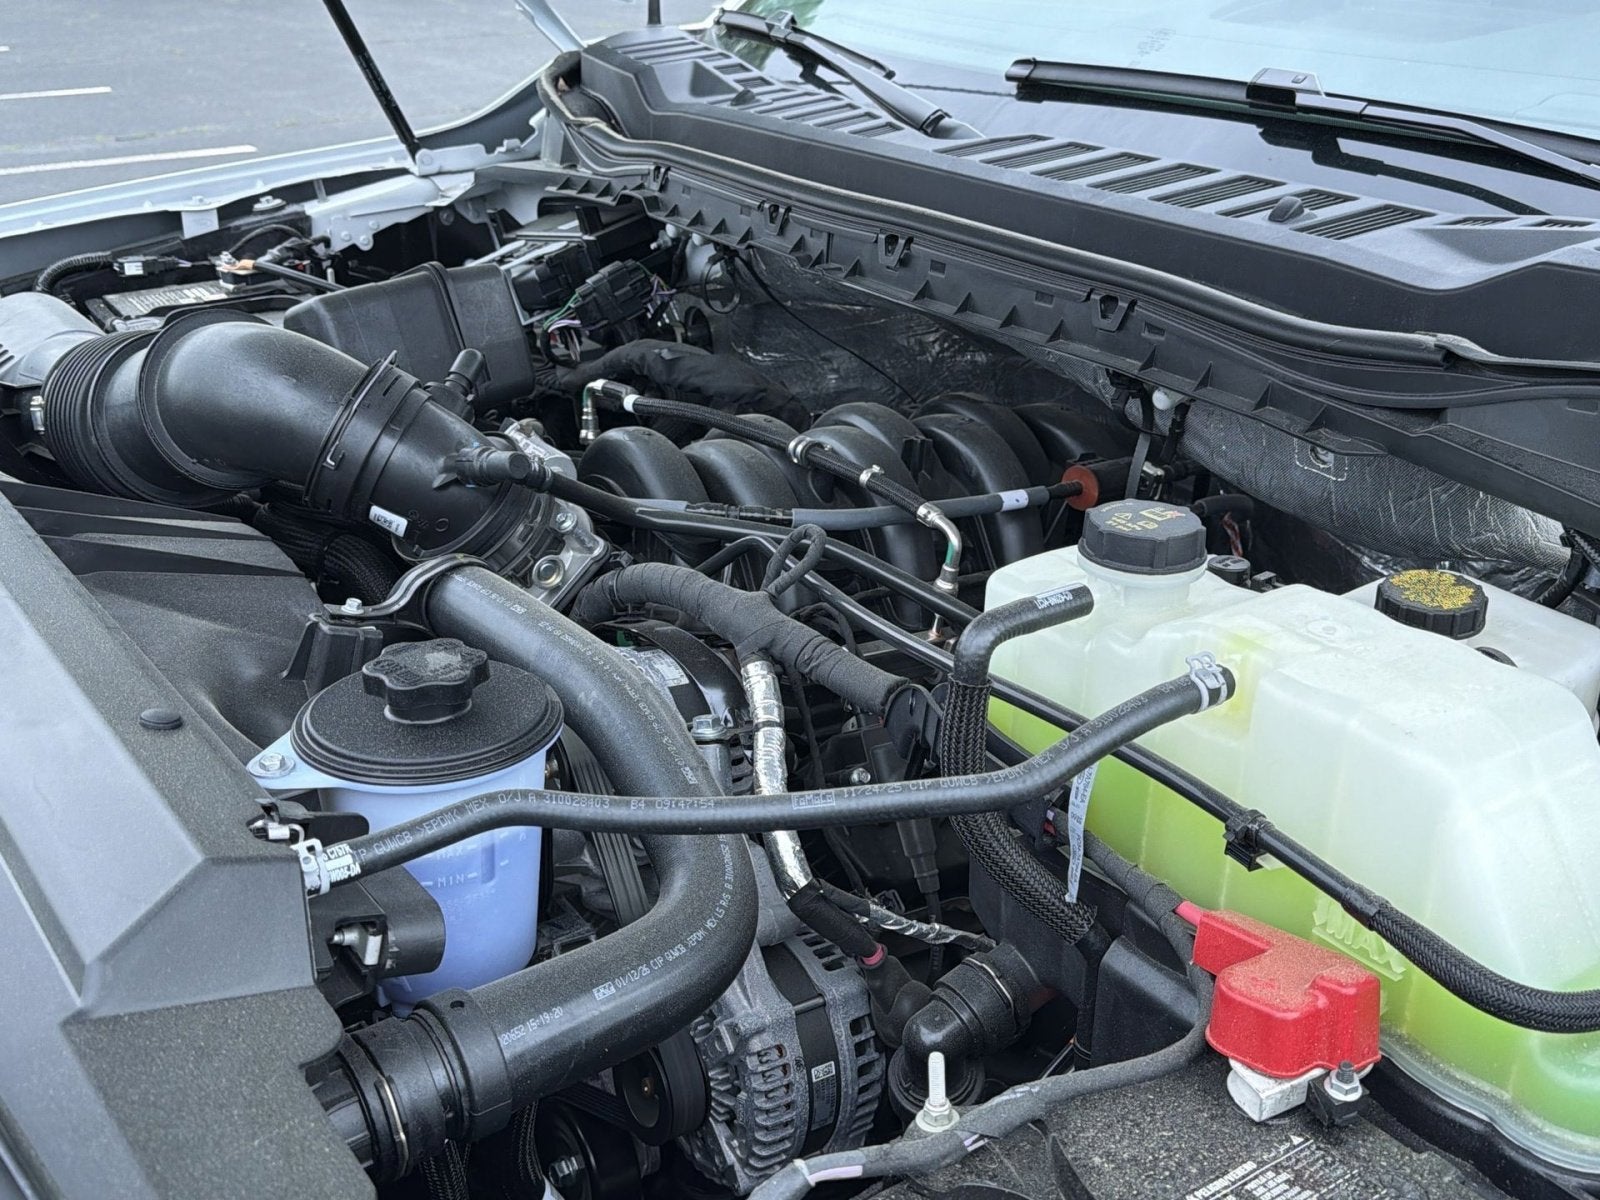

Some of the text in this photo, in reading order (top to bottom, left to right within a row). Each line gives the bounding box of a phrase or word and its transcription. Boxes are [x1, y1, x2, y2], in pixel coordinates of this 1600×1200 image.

[465, 798, 490, 815] MEX
[909, 780, 932, 792] CIP
[438, 873, 464, 888] MIN
